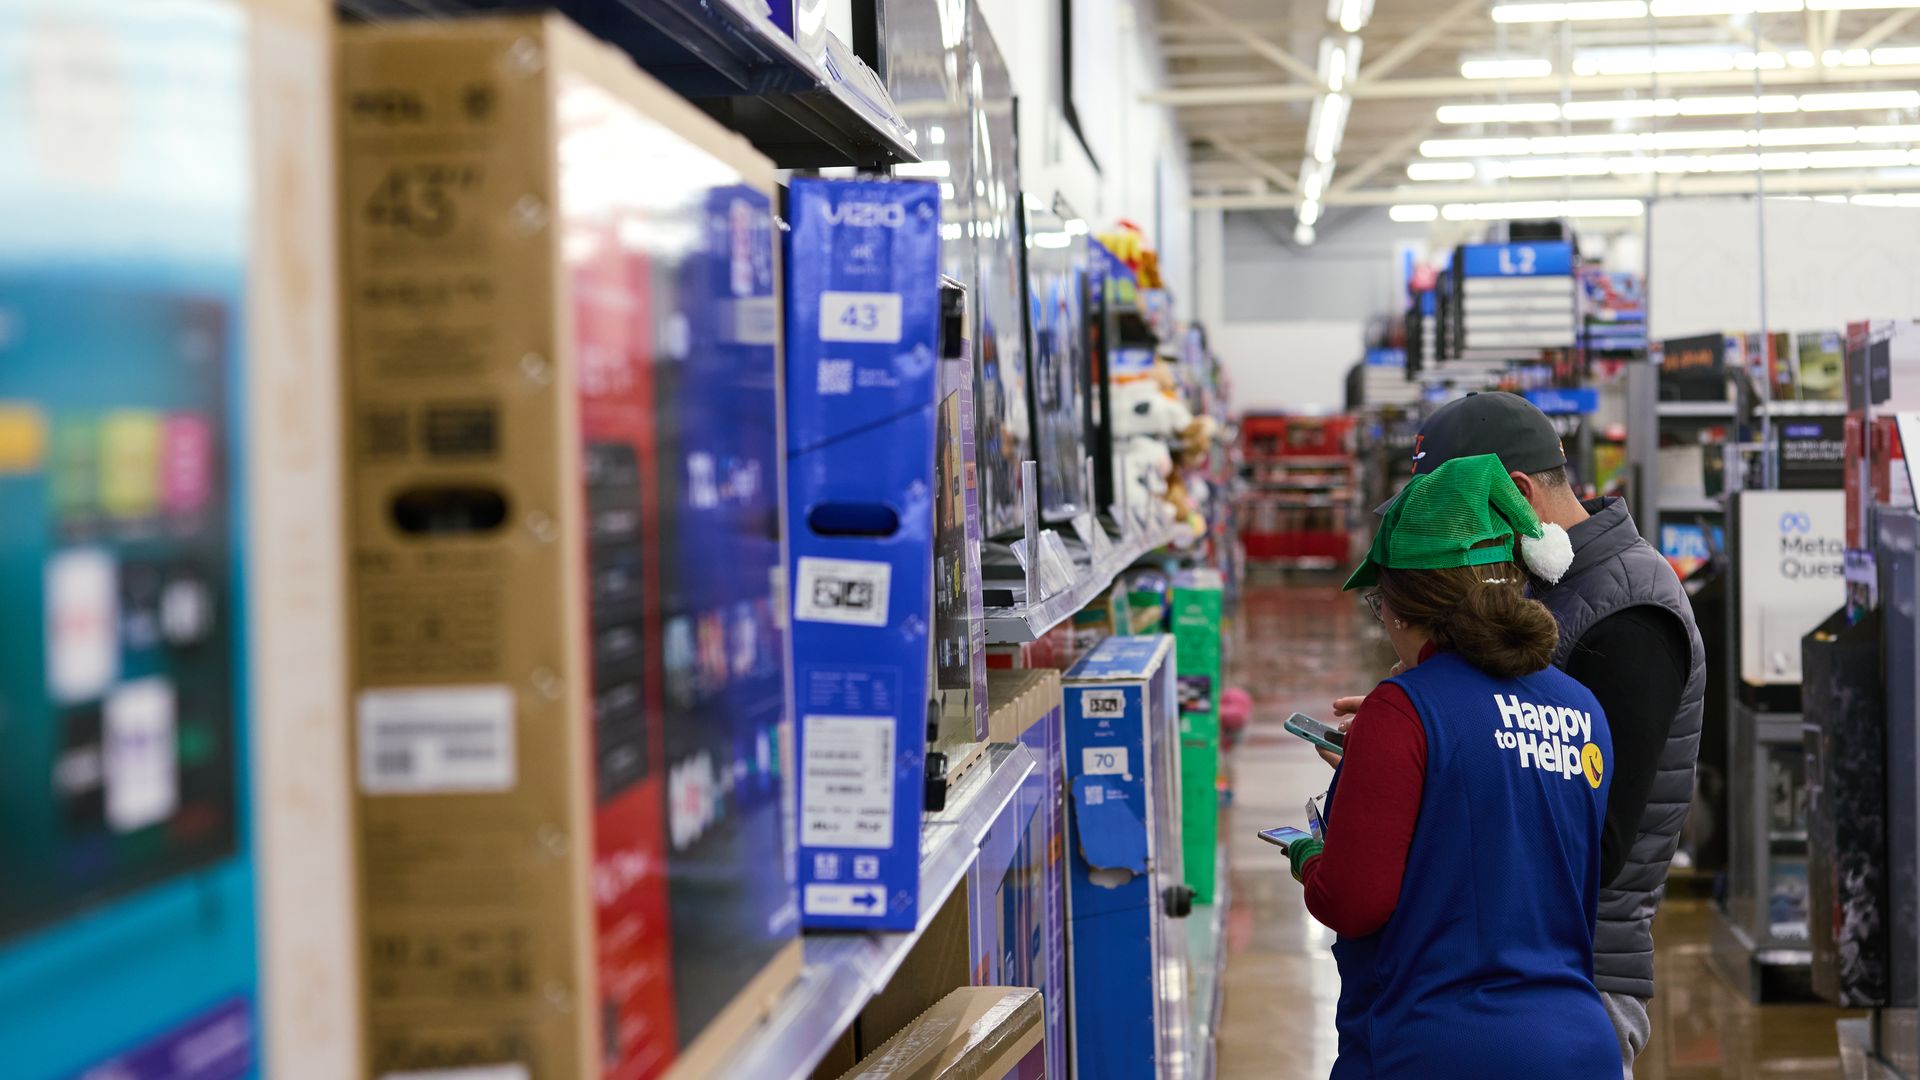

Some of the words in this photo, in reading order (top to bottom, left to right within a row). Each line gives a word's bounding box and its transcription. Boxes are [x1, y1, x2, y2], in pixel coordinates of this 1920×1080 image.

[1780, 558, 1844, 582] Ques
[1493, 694, 1592, 744] Happy
[1494, 729, 1517, 749] to
[1516, 731, 1583, 780] Help
